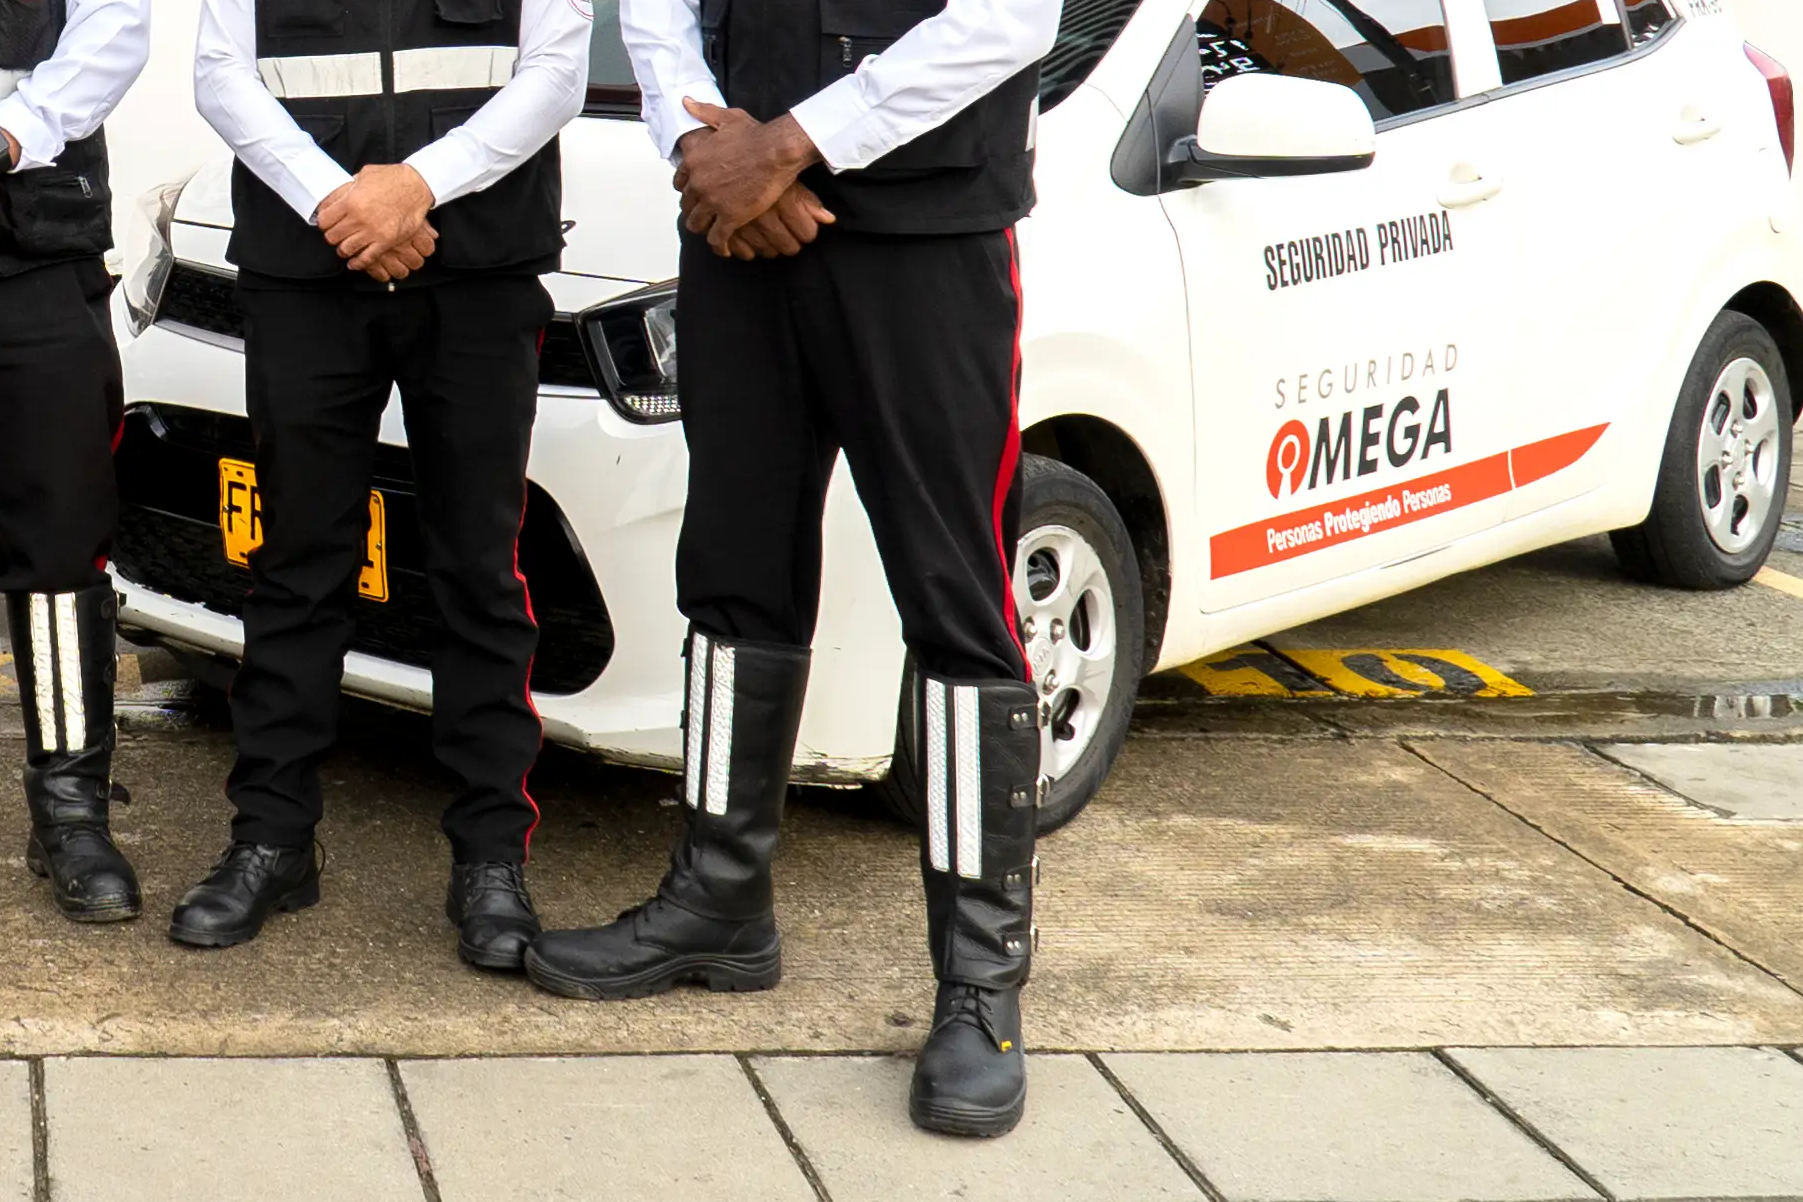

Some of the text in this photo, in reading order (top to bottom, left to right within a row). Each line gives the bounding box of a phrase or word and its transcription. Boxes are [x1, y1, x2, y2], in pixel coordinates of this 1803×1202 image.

[1263, 209, 1454, 291] SEGURIDAD PRIVADA
[1274, 344, 1459, 409] SEGURIDAD
[1265, 387, 1453, 501] OMEGA
[1266, 482, 1452, 554] Personas Protegiendo Personas
